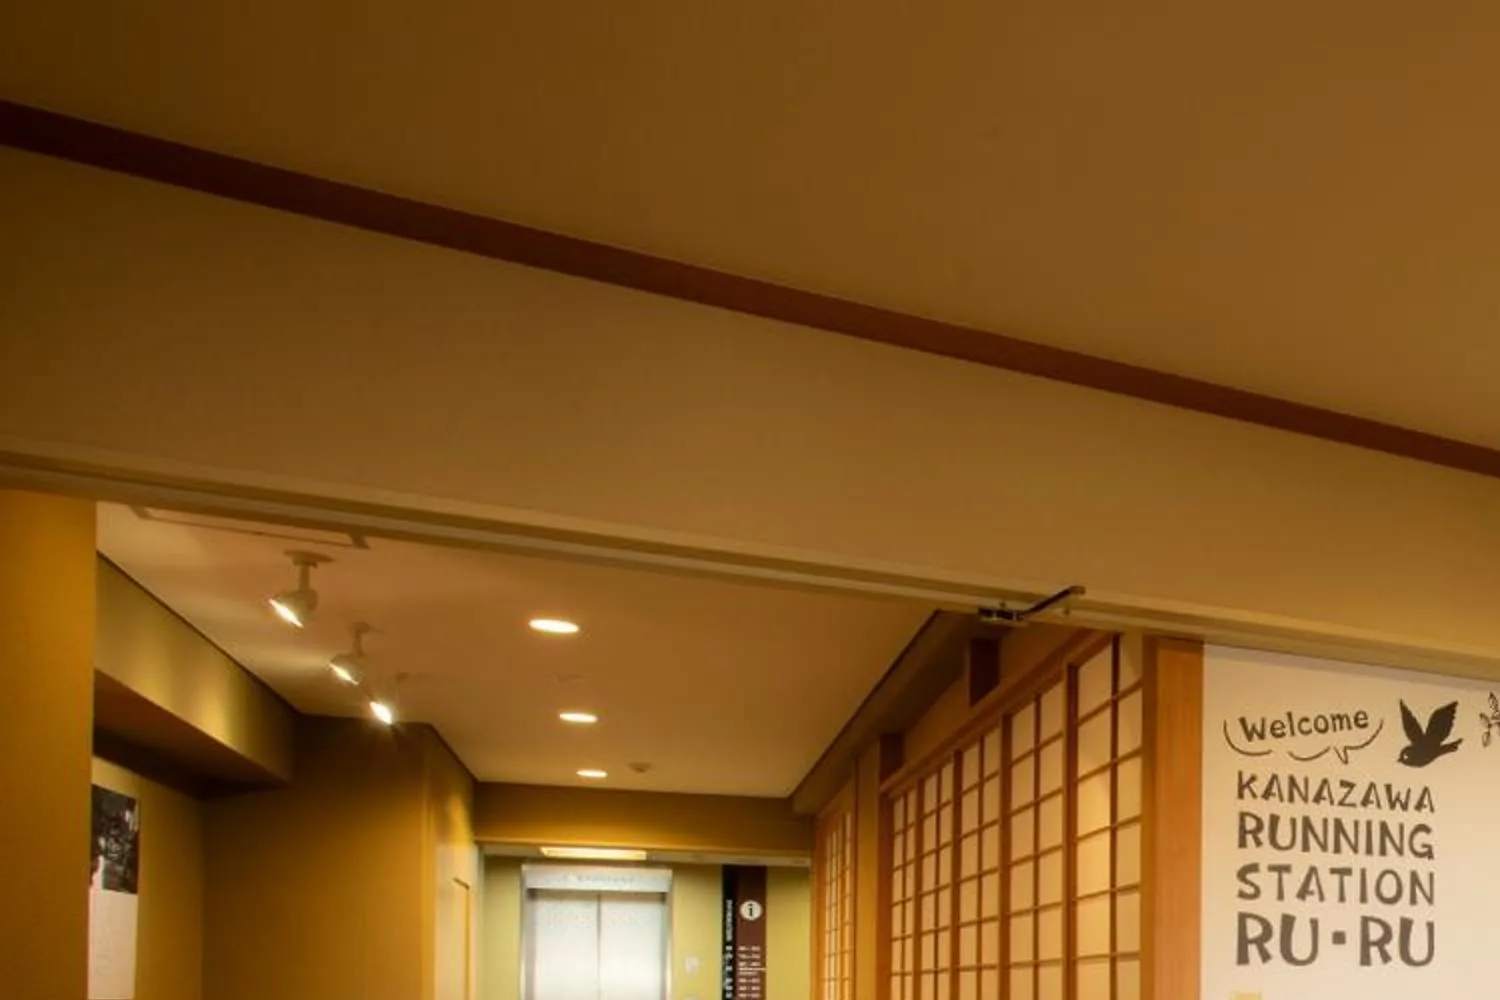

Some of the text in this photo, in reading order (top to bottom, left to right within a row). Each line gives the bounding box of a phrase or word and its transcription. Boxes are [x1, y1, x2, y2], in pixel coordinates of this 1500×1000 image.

[1238, 710, 1369, 742] Welcome
[1237, 770, 1435, 814] KANAZAWA
[1237, 811, 1435, 860] RUNNING
[1236, 862, 1435, 906] STATION
